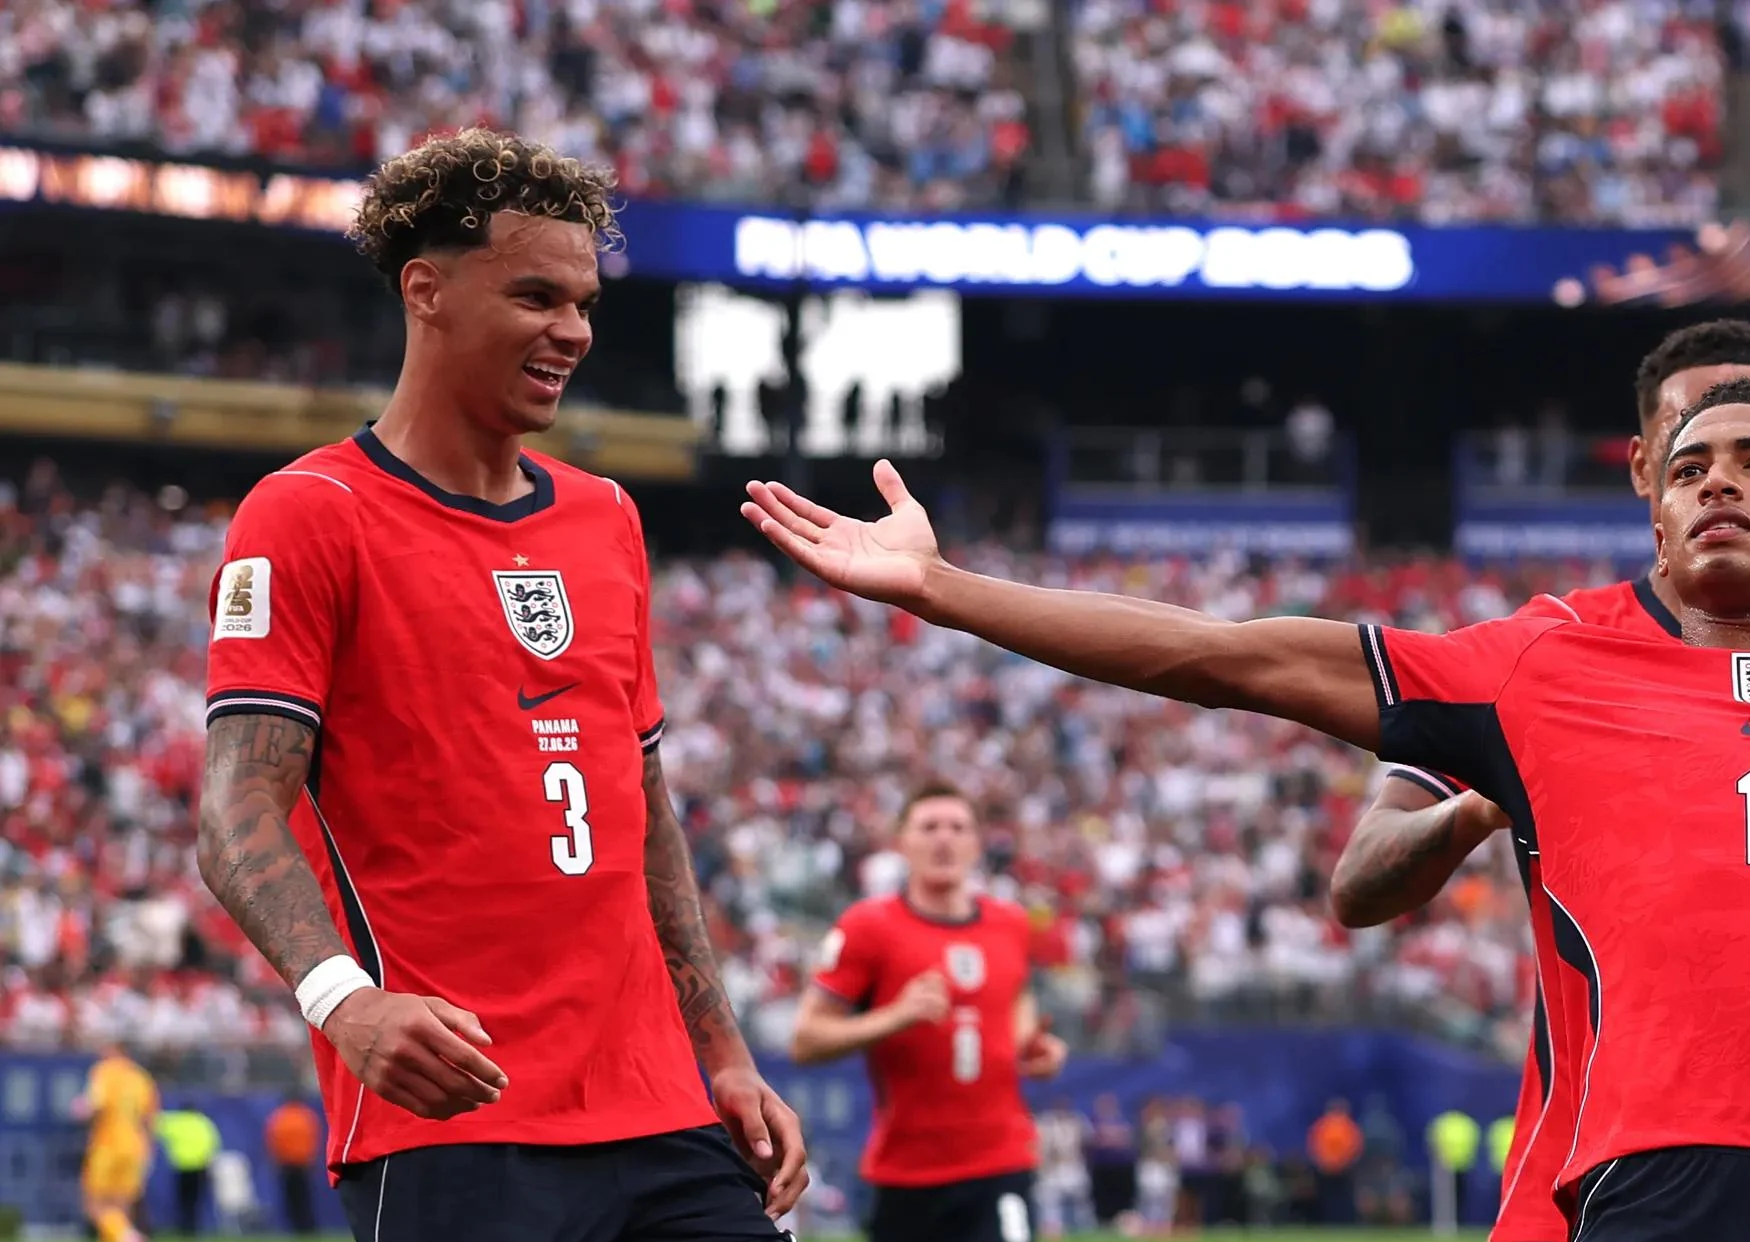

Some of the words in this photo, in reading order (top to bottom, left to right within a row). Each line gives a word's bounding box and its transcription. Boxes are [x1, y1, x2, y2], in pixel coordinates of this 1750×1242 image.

[531, 719, 579, 734] PANAMA
[538, 737, 578, 752] 27.06.26
[543, 761, 594, 875] 3
